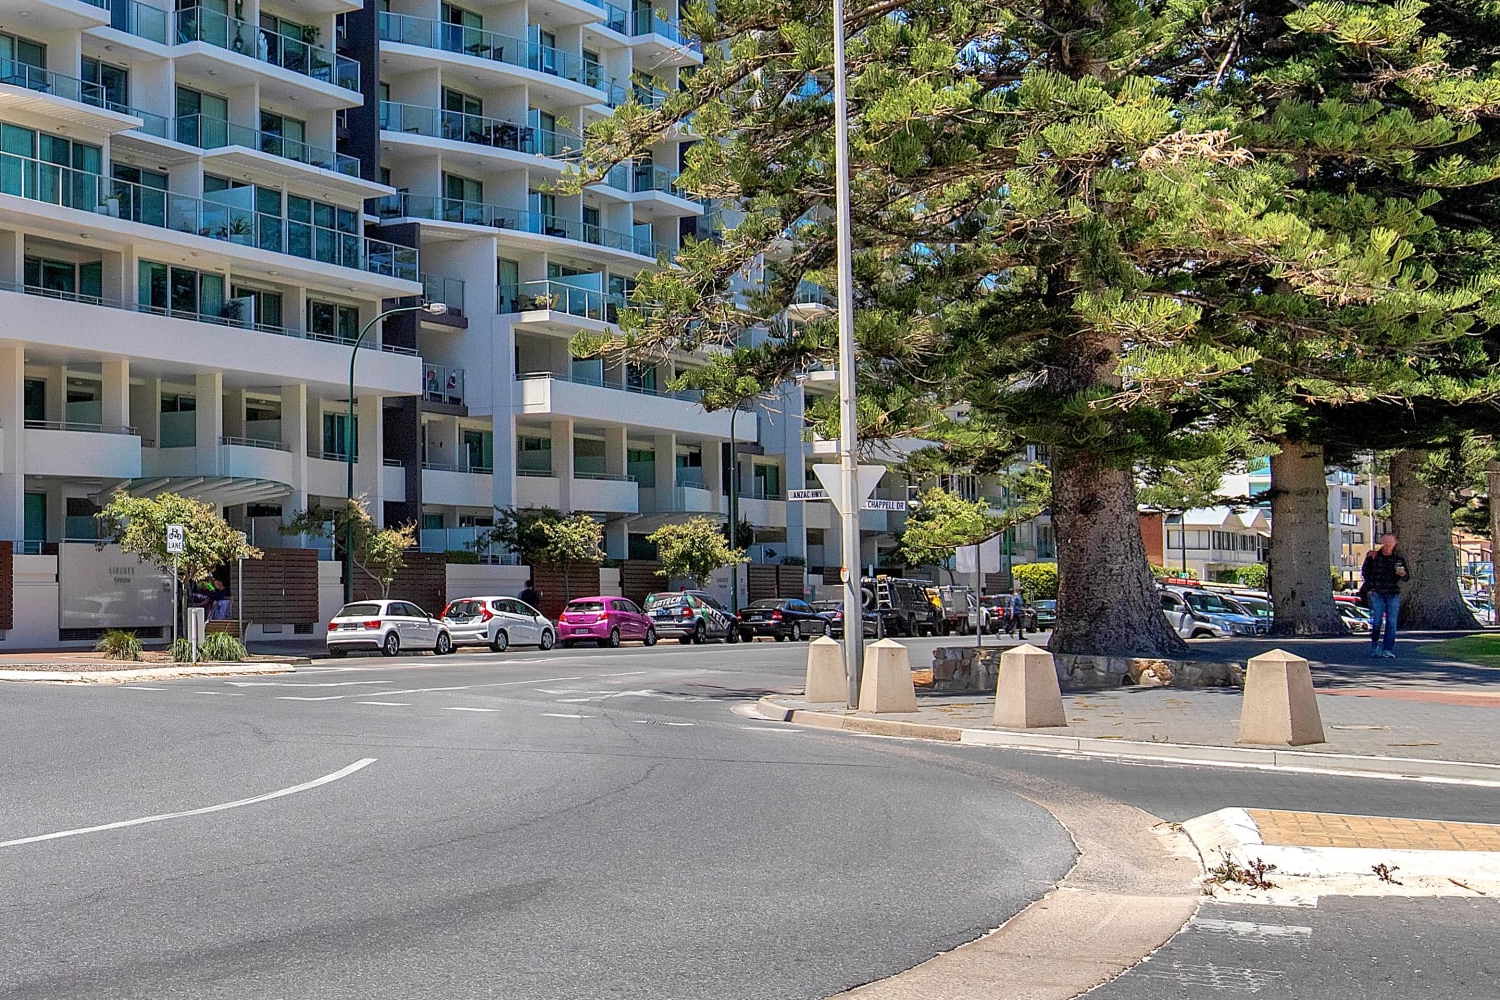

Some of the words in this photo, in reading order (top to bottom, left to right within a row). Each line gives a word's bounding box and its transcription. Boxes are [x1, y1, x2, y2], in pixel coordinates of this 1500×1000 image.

[793, 490, 810, 499] ANZAC
[811, 490, 823, 498] HWY
[867, 500, 895, 509] CHAPPELL
[896, 502, 905, 510] DR
